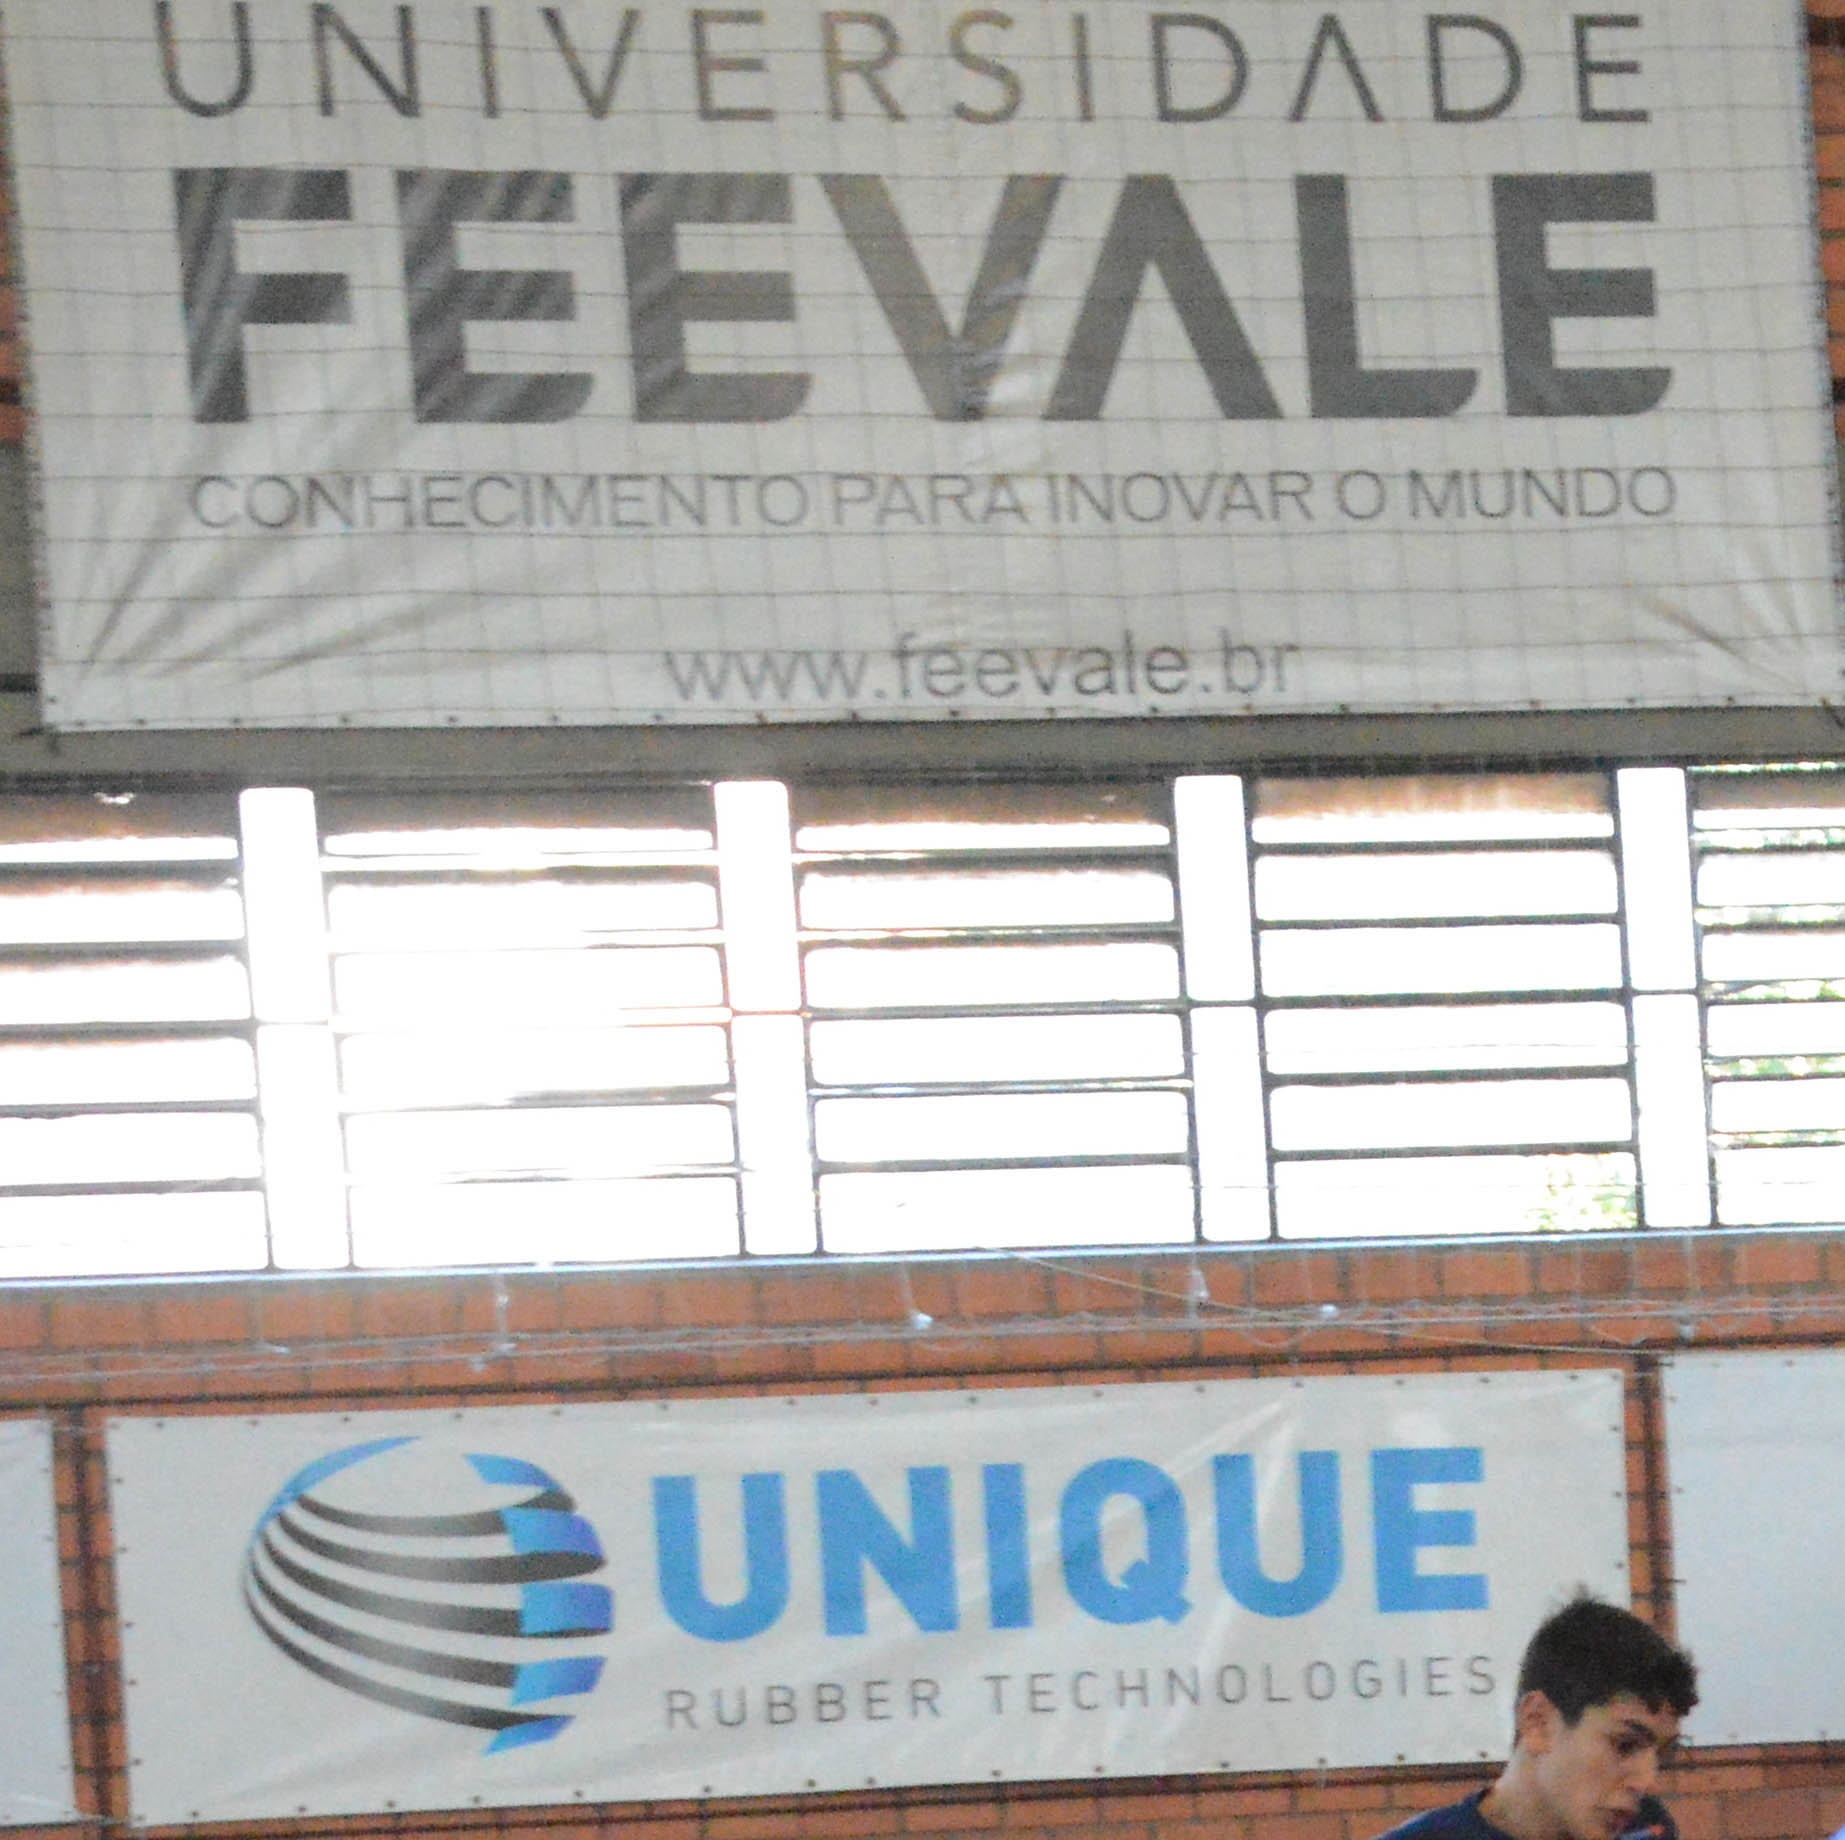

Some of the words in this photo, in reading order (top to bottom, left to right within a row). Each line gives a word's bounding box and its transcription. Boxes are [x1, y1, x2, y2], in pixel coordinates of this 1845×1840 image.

[155, 1, 1651, 123] UNIVERSIDADE
[173, 168, 1676, 427] FEEVALE
[191, 474, 810, 530] CONHECIMENTO
[832, 473, 1027, 527] PARA
[1045, 469, 1314, 525] INOVAR
[1337, 468, 1386, 519] O
[1409, 465, 1677, 519] MUNDO
[664, 628, 1301, 701] www.feevale.br
[651, 1445, 1490, 1642] UNIQUE
[663, 1677, 943, 1730] RUBBER
[986, 1654, 1497, 1713] TECHNOLOGIES
